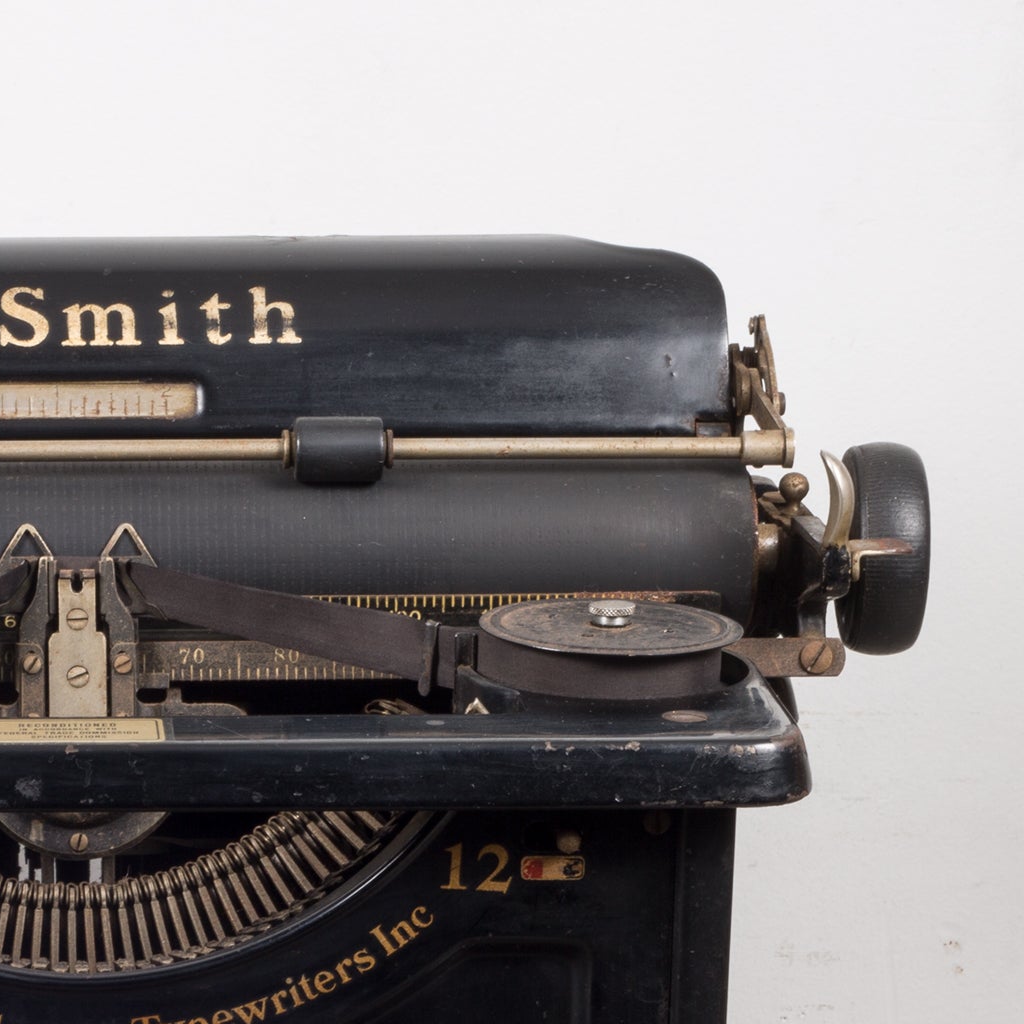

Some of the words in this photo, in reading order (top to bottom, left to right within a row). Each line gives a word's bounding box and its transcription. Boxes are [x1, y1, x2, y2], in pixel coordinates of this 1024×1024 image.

[179, 648, 205, 665] 70
[274, 648, 299, 665] 80
[440, 842, 513, 894] 12
[369, 905, 434, 957] Inc
